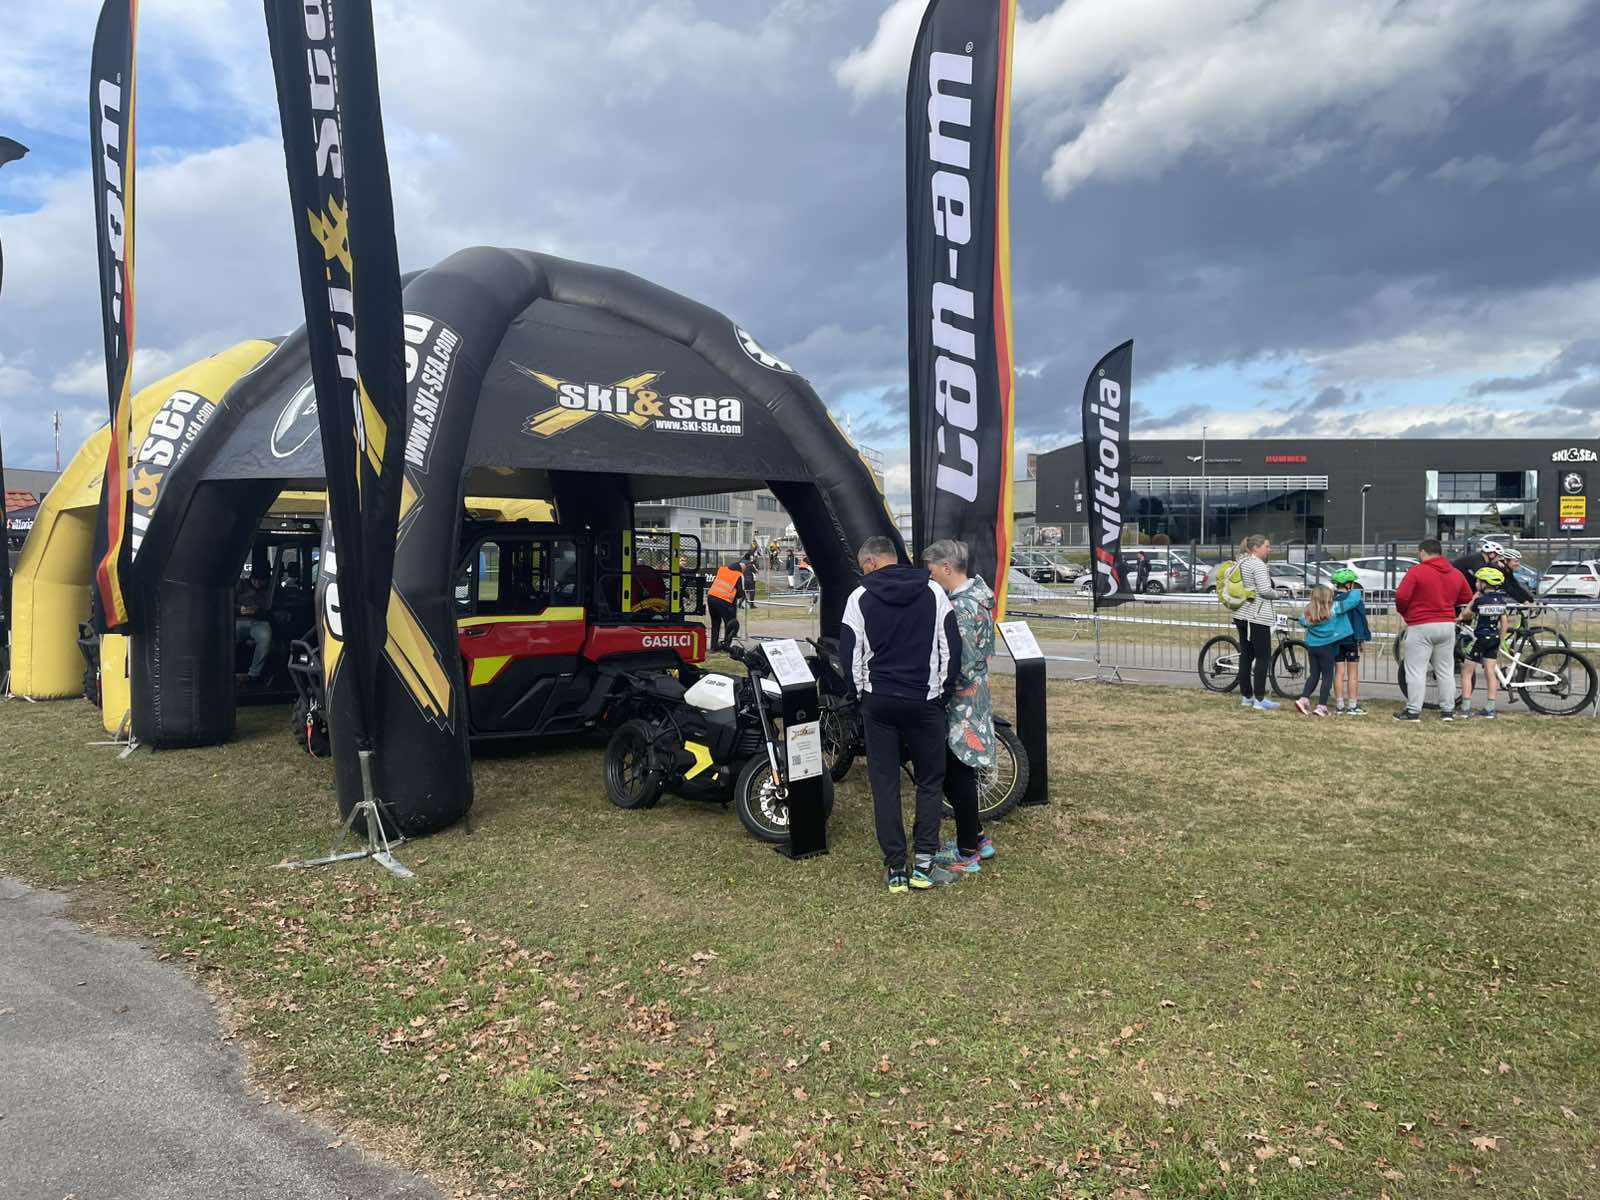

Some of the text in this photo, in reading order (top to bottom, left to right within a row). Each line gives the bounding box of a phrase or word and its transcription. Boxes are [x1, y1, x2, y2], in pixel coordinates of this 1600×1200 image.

[927, 51, 979, 503] can-am
[139, 391, 200, 467] sea
[633, 389, 665, 418] &
[668, 395, 742, 422] sea
[1091, 378, 1122, 546] vittoria
[642, 635, 691, 648] GASILCI
